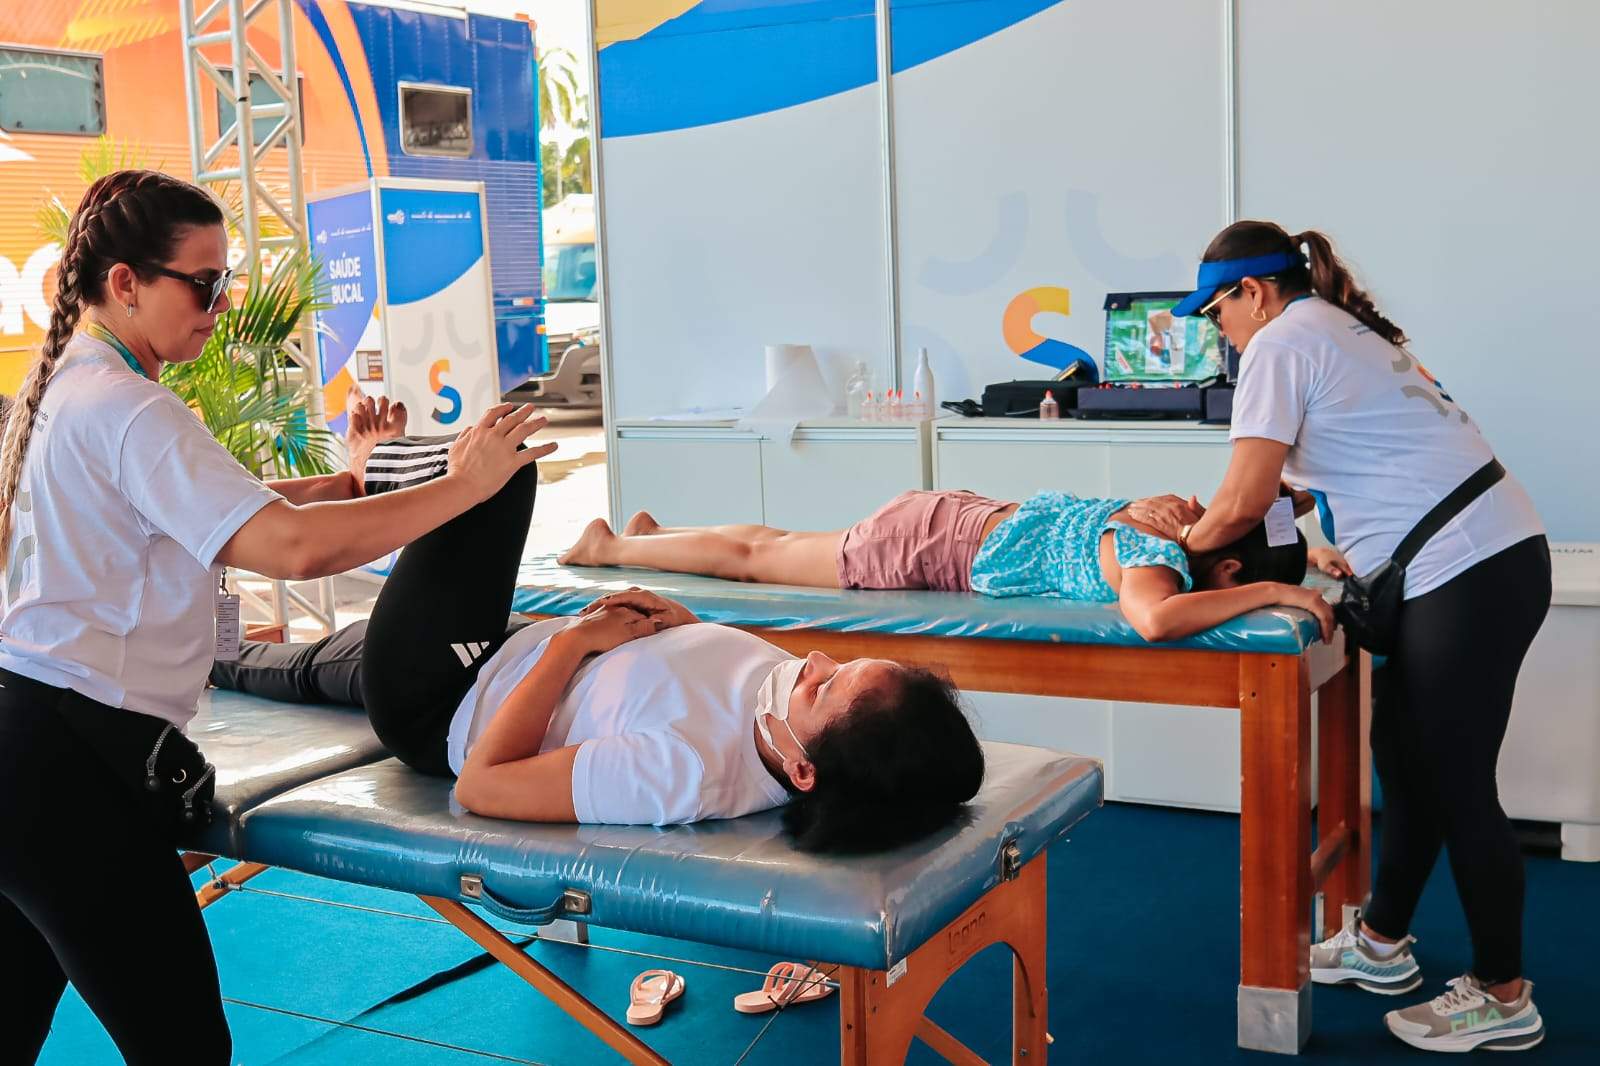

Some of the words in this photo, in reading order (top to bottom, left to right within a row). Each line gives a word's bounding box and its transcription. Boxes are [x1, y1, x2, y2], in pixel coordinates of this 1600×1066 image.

[329, 251, 361, 279] SAÚDE
[331, 283, 364, 304] BUCAL
[1450, 1007, 1504, 1032] FILA
